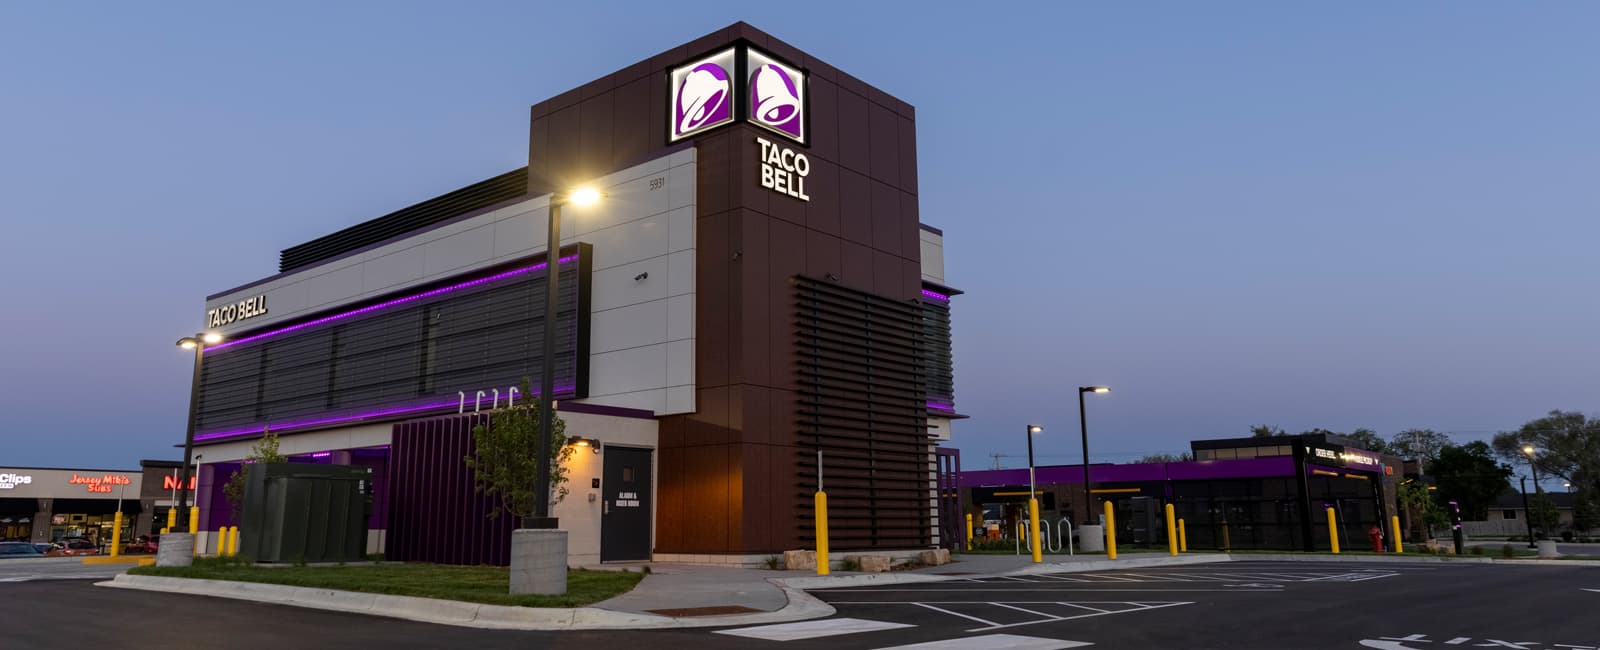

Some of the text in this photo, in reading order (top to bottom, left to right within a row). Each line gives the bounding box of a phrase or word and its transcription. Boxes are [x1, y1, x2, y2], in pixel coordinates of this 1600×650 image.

[756, 136, 810, 177] TACO
[649, 176, 665, 191] 5931
[761, 163, 810, 202] BELL
[207, 295, 267, 328] TACO BELL
[0, 473, 32, 485] Clips
[69, 474, 102, 485] Jersey
[87, 483, 112, 493] Subs
